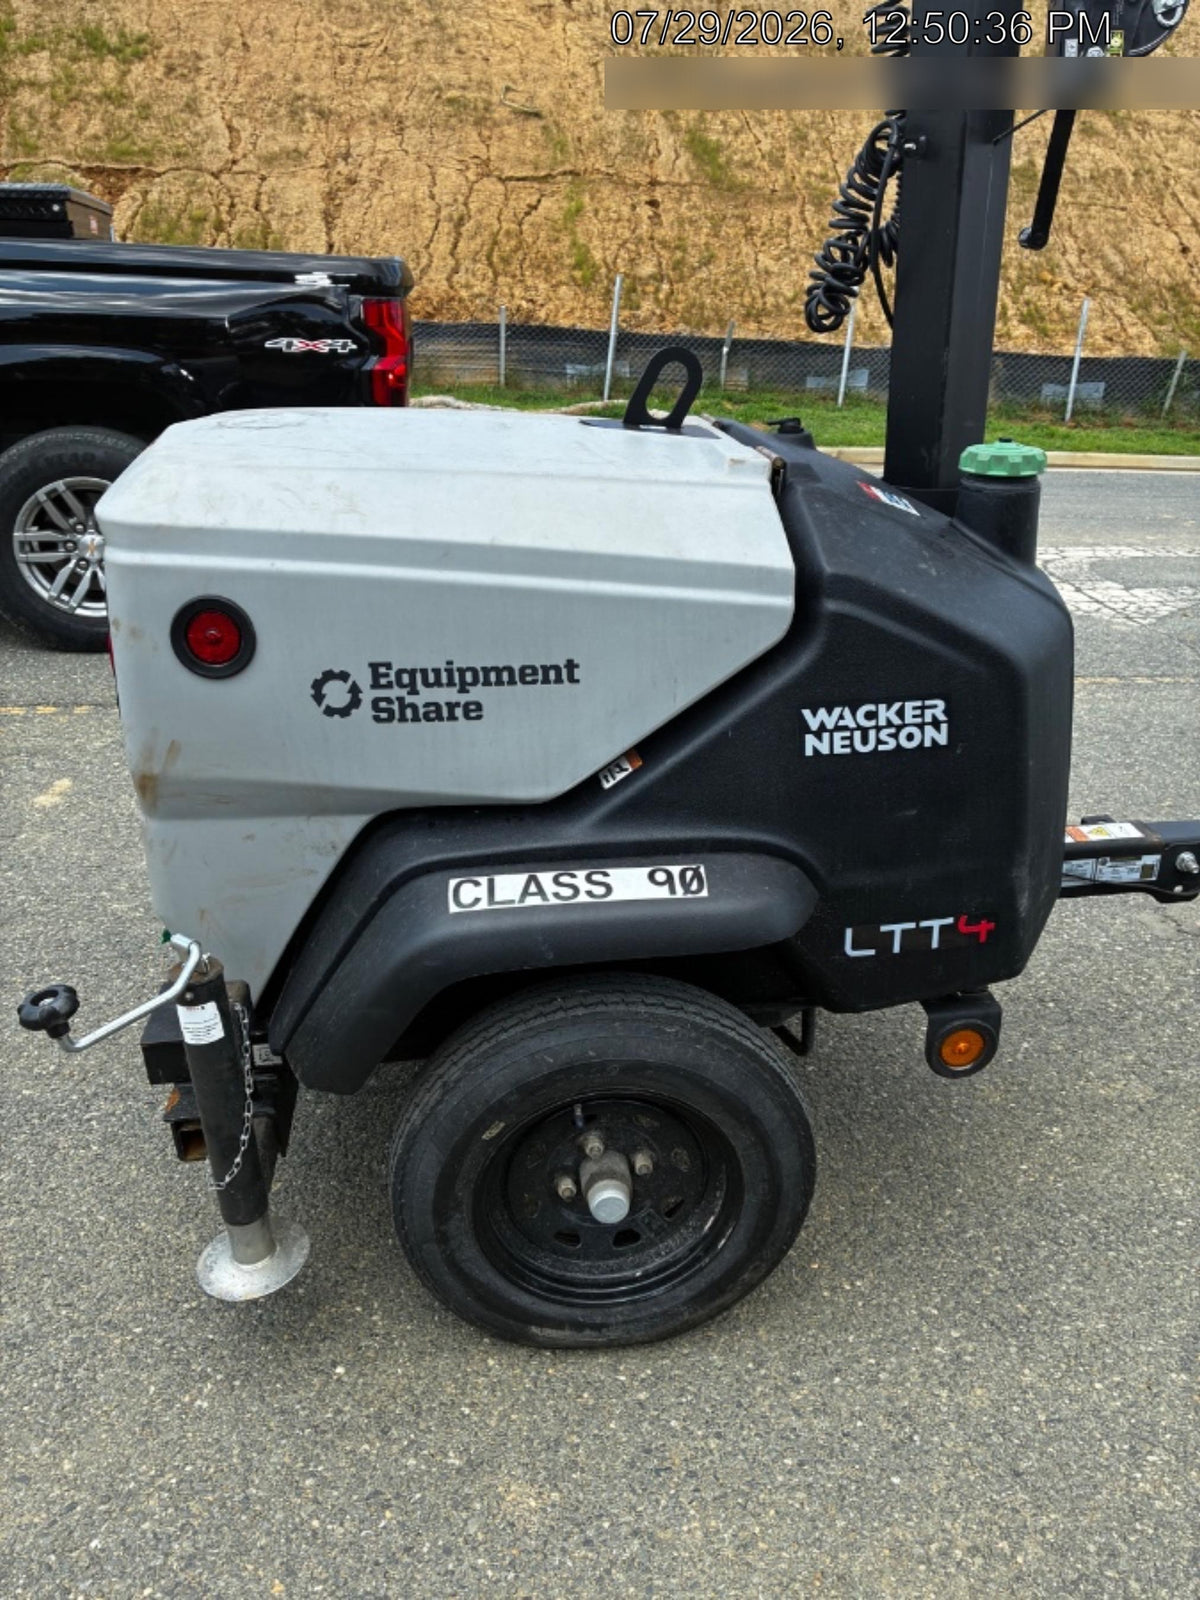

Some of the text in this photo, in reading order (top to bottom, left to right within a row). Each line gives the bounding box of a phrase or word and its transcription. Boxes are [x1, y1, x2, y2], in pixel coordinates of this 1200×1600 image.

[368, 658, 580, 695] Equipment
[371, 696, 483, 724] Share
[801, 699, 948, 731] WACKER
[804, 722, 948, 756] NEUSON
[452, 869, 613, 909] CLASS
[844, 914, 995, 957] LTT4
